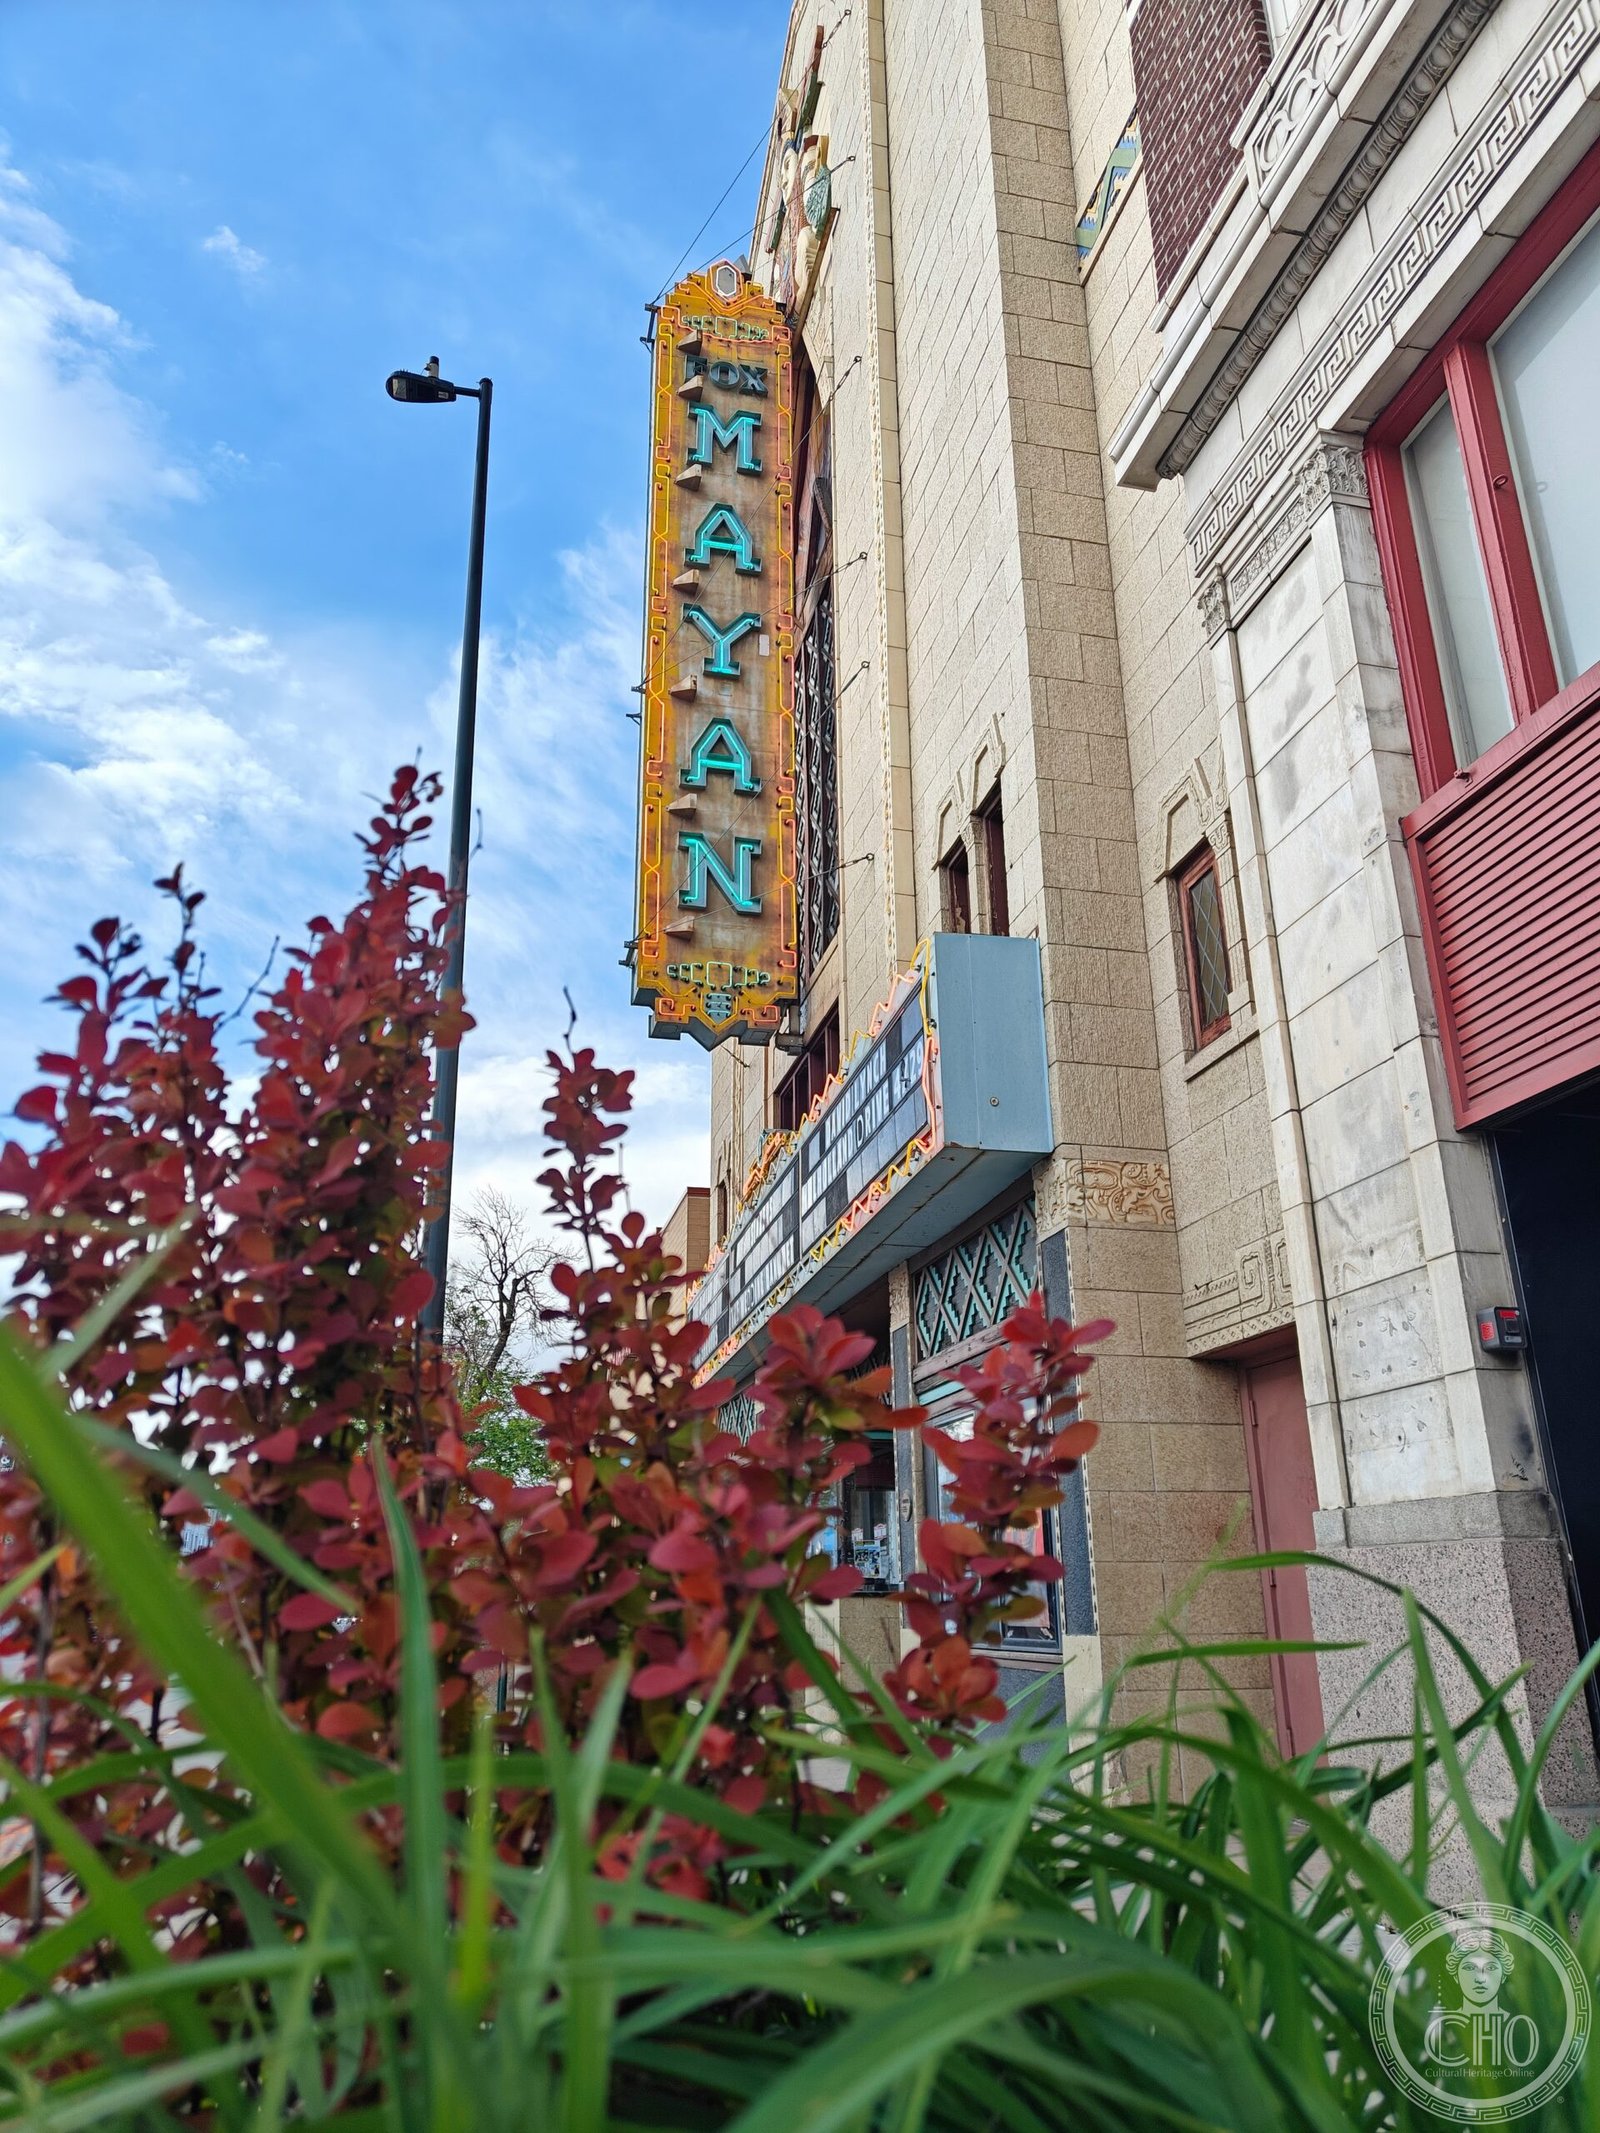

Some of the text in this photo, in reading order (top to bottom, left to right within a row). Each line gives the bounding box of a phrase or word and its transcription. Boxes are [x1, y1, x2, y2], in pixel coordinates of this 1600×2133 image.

[684, 354, 769, 399] FOX
[676, 400, 763, 916] MAYAN
[854, 1038, 886, 1112] LYNCH
[856, 1077, 889, 1148] DRIVE
